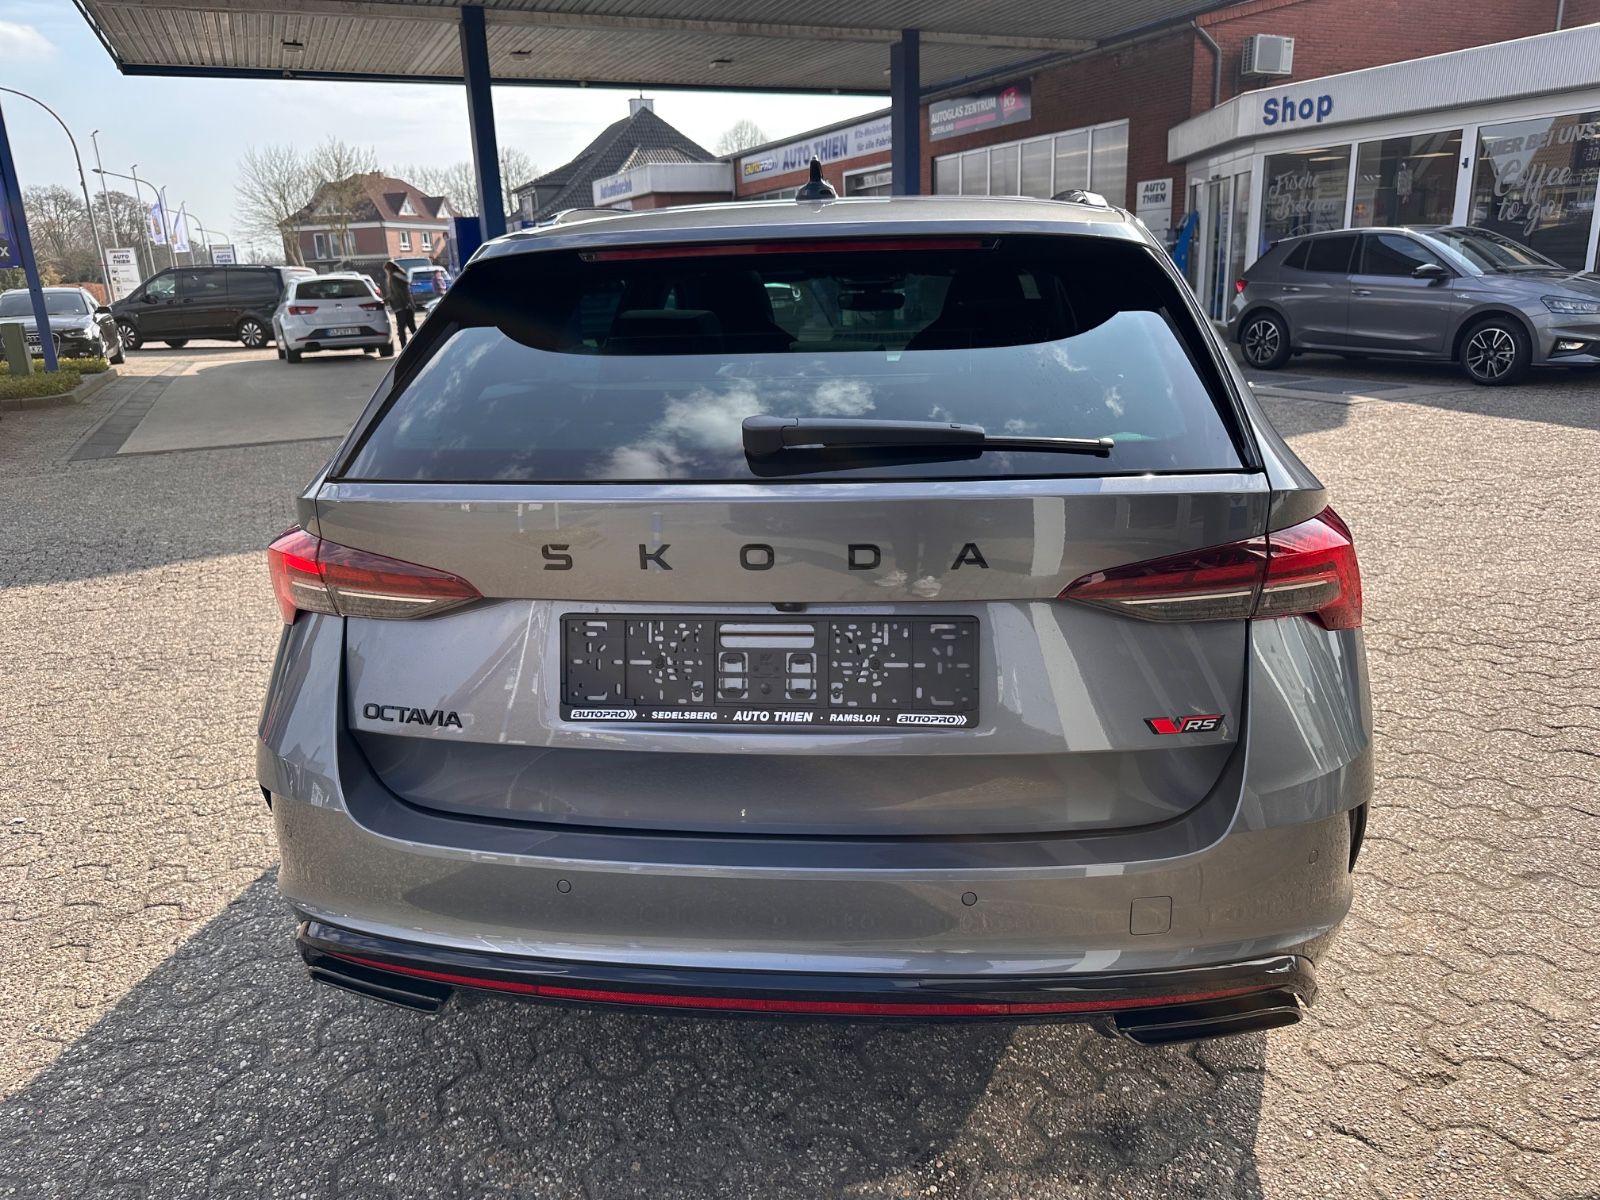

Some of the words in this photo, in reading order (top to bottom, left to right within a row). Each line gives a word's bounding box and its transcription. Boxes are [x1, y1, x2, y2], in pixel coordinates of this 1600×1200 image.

[931, 105, 963, 124] AUTOGLAS
[964, 96, 996, 117] ZENTRUM
[1263, 94, 1333, 126] Shop
[1525, 130, 1555, 151] BEI
[1560, 122, 1596, 144] UNS
[782, 144, 811, 171] AUTO
[813, 134, 848, 161] THIEN
[1144, 182, 1166, 193] AUTO
[1268, 170, 1320, 199] Frische
[1494, 160, 1571, 205] Coffee
[1142, 193, 1167, 204] THIEN
[1497, 198, 1520, 221] to
[541, 543, 989, 571] SKODA
[363, 703, 463, 728] OCTAVIA
[651, 711, 718, 720] SEDELSBERG
[733, 711, 770, 721] AUTO
[774, 711, 814, 722] THIEN
[829, 713, 881, 723] RAMSLOH
